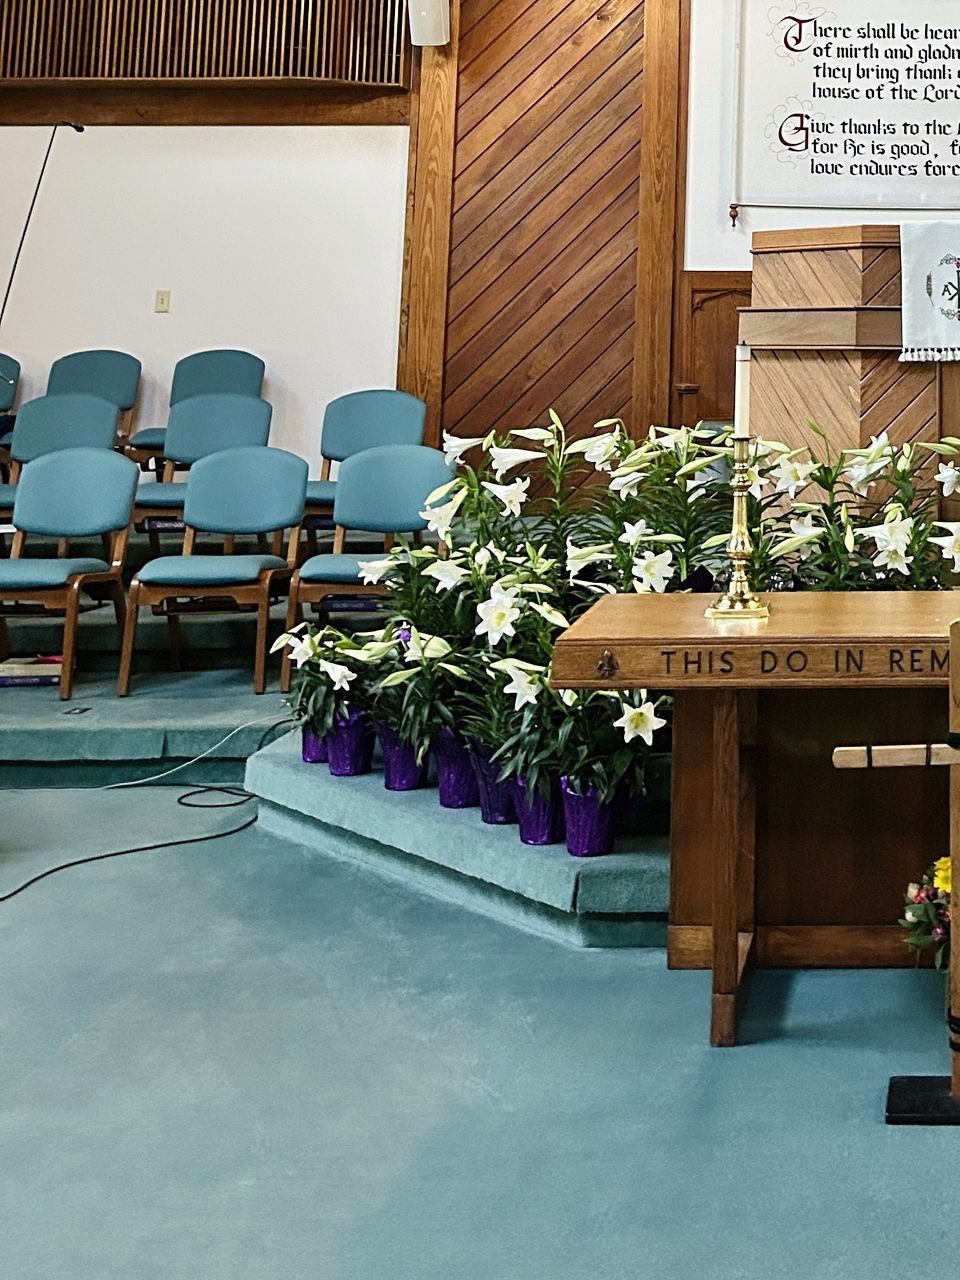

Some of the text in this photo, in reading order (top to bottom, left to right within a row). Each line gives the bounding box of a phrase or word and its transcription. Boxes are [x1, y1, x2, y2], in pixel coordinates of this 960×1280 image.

[778, 16, 852, 52] There
[857, 22, 896, 39] shall
[900, 22, 920, 40] be
[812, 42, 833, 58] of
[836, 43, 879, 59] mirth
[884, 43, 914, 60] and
[813, 62, 851, 83] they
[856, 63, 899, 84] bring
[905, 64, 952, 80] thank
[812, 82, 861, 100] house
[865, 83, 885, 100] of
[890, 83, 918, 101] the
[778, 113, 835, 152] Give
[840, 118, 897, 135] thanks
[901, 122, 920, 135] to
[924, 119, 952, 136] the
[811, 137, 838, 154] for
[843, 137, 866, 158] He
[870, 140, 886, 156] is
[810, 158, 845, 176] love
[849, 159, 919, 177] endures
[661, 650, 735, 674] THIS
[760, 650, 809, 674] DO
[834, 650, 865, 673] IN
